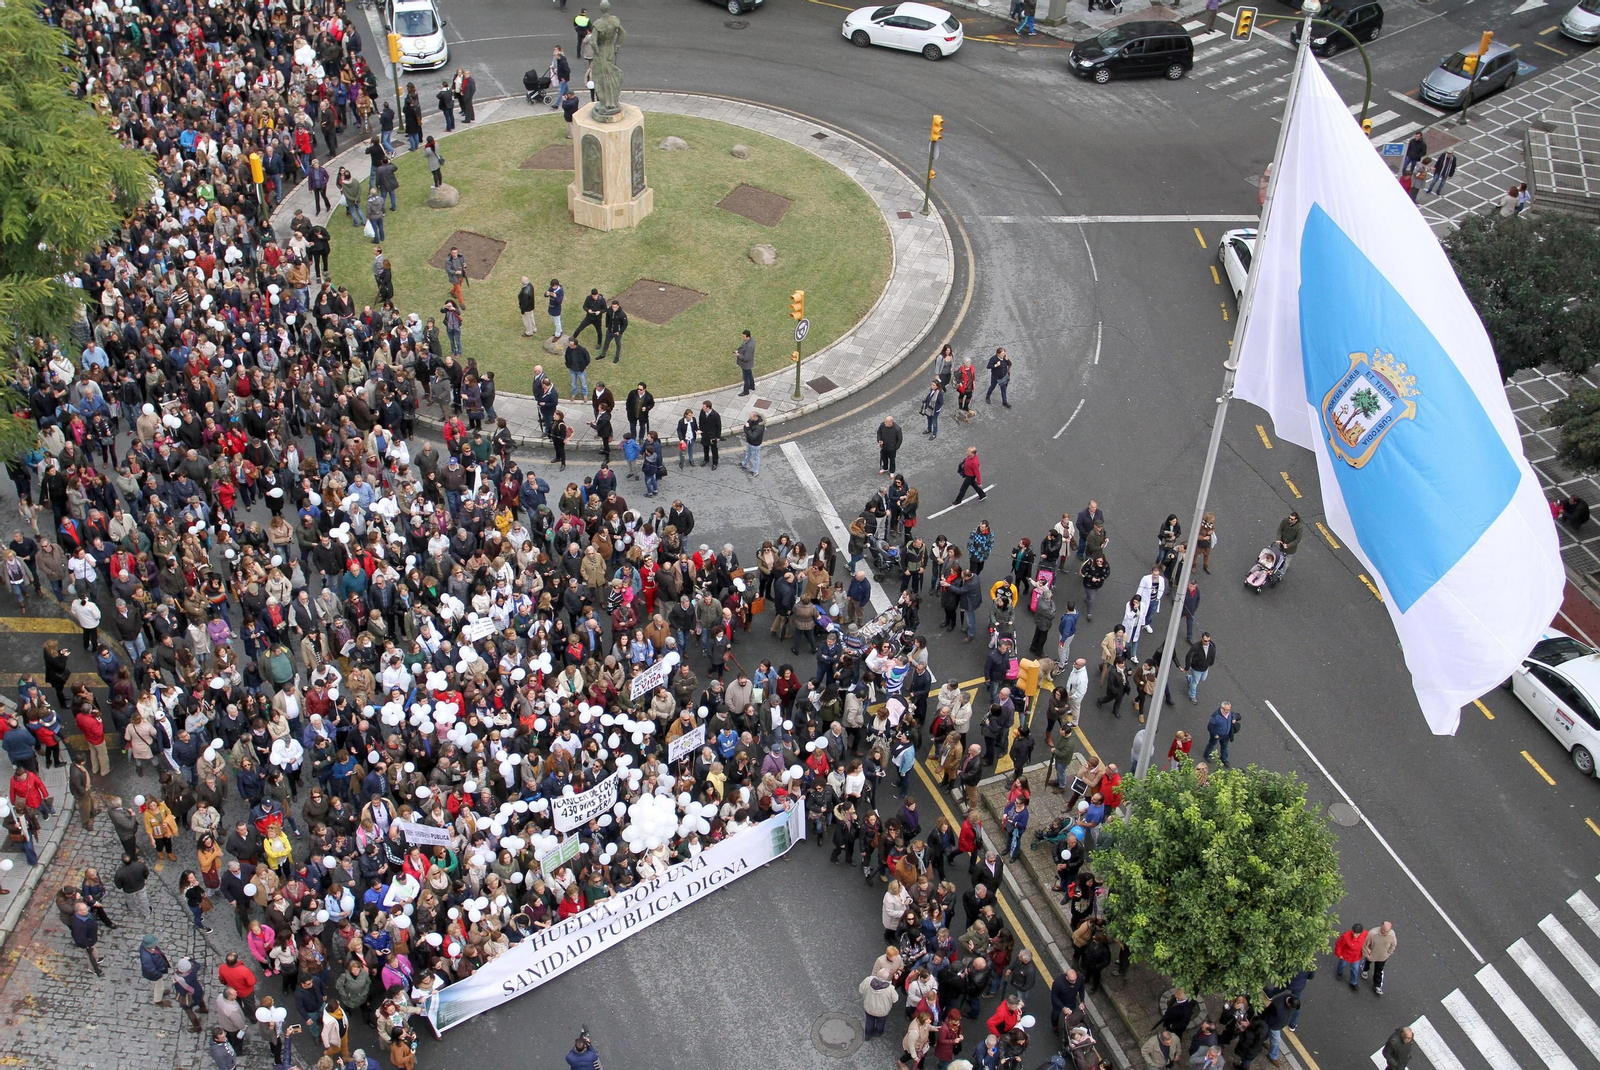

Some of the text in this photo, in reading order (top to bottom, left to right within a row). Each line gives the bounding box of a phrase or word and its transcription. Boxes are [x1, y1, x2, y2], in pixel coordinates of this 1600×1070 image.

[1365, 371, 1375, 380] ET
[1328, 369, 1360, 413] PORTUS MARIS
[1362, 415, 1392, 446] CUSTODIA
[641, 672, 662, 690] VIDA
[561, 805, 577, 818] 430
[574, 798, 611, 823] DE ESPERA
[531, 855, 708, 952] HUELVA, POR UNA
[502, 935, 592, 997] SANIDAD
[686, 857, 749, 898] DIGNA
